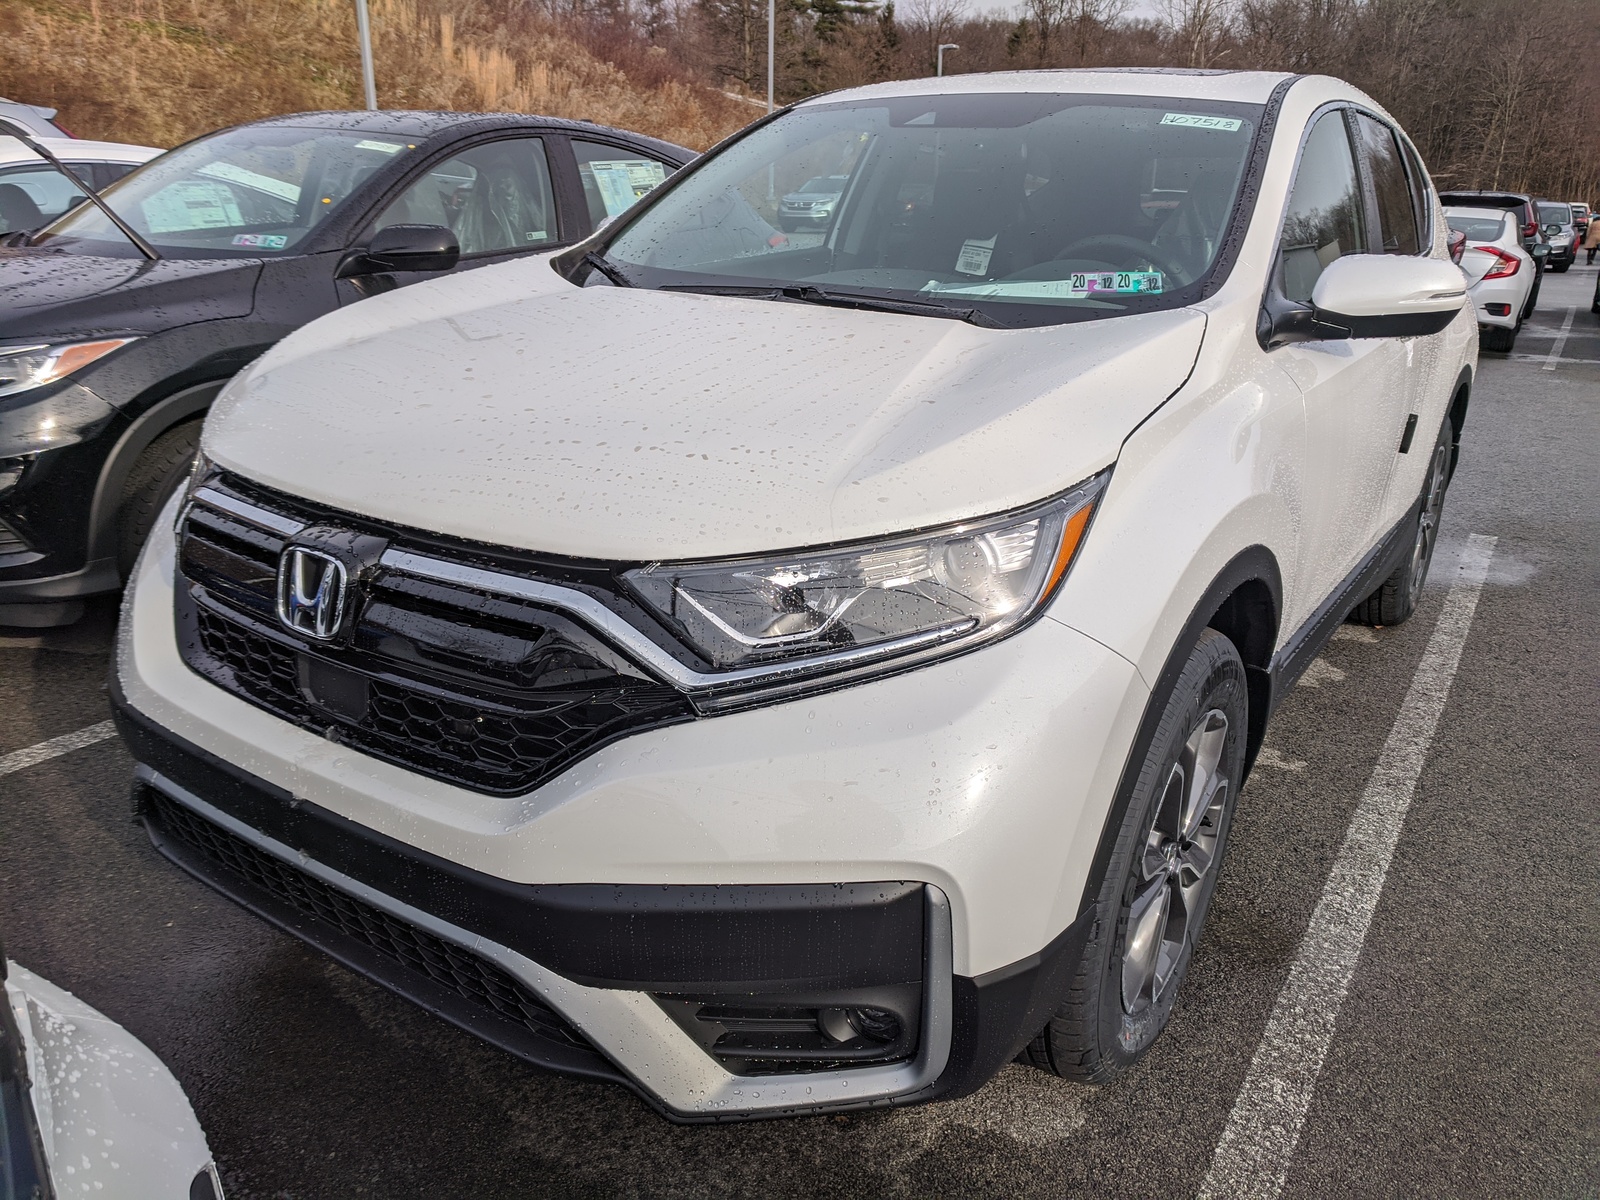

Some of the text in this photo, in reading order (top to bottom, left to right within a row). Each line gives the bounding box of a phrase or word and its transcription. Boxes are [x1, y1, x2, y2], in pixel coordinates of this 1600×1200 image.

[1072, 274, 1086, 288] 20
[1102, 276, 1113, 289] 12
[1117, 273, 1131, 288] 20
